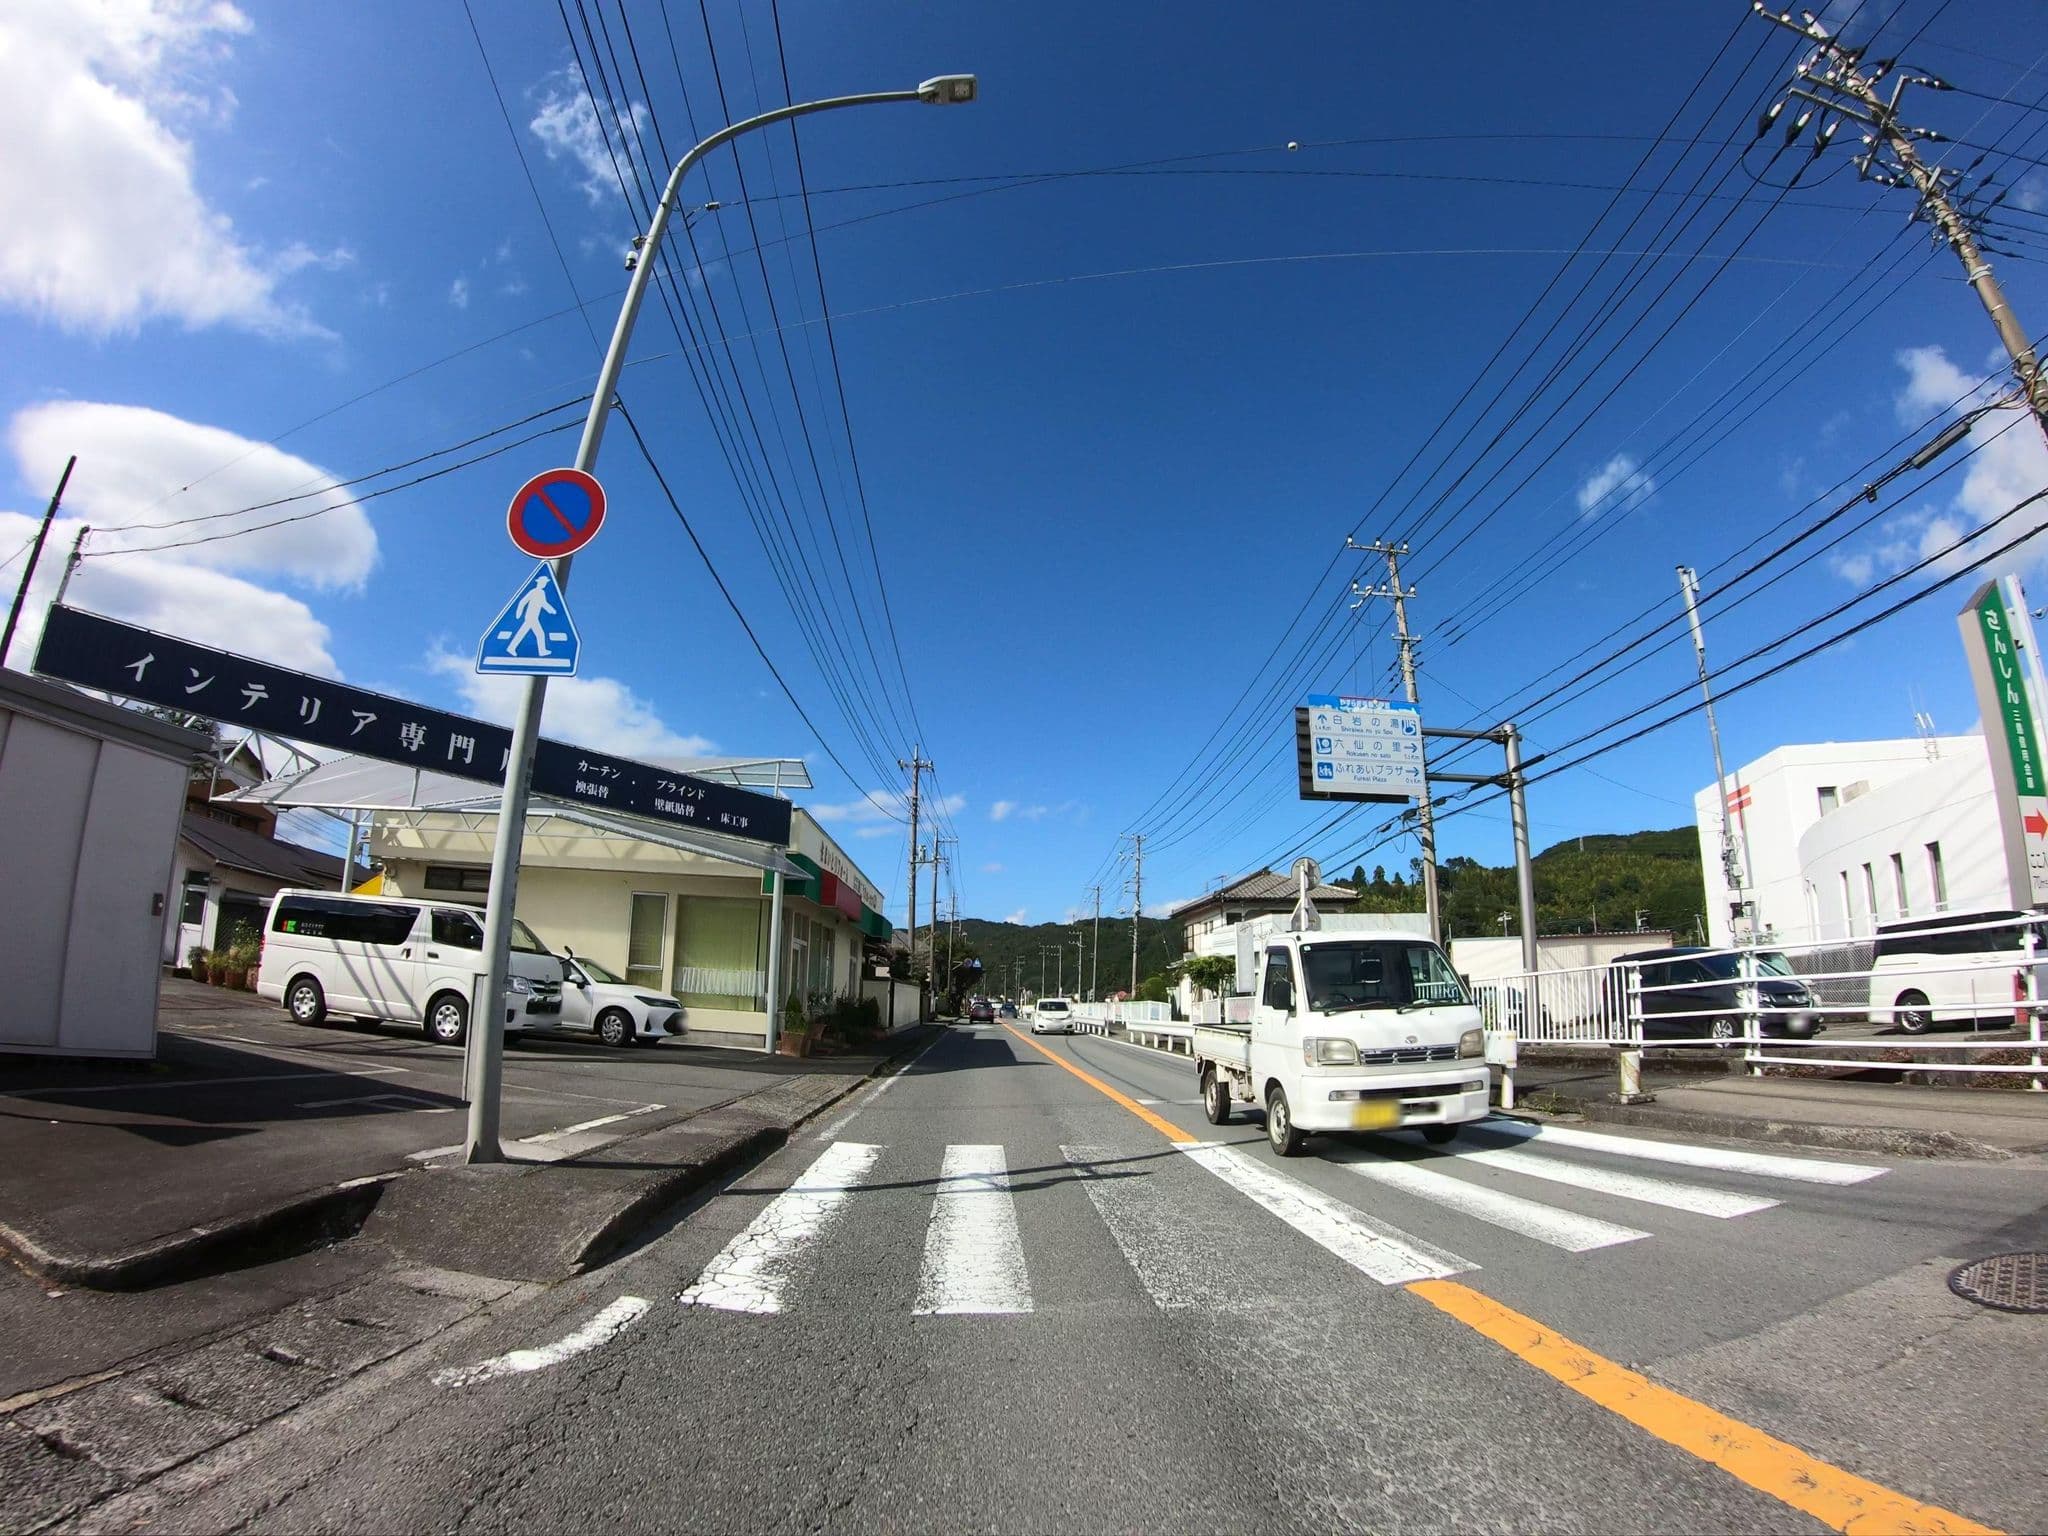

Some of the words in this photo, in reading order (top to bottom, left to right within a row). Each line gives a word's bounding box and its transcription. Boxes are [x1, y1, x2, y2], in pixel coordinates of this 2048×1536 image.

[1985, 608, 2020, 705] さんしん
[1334, 739, 1401, 752] 六仙の里
[1335, 762, 1404, 776] ふれあいプラザ
